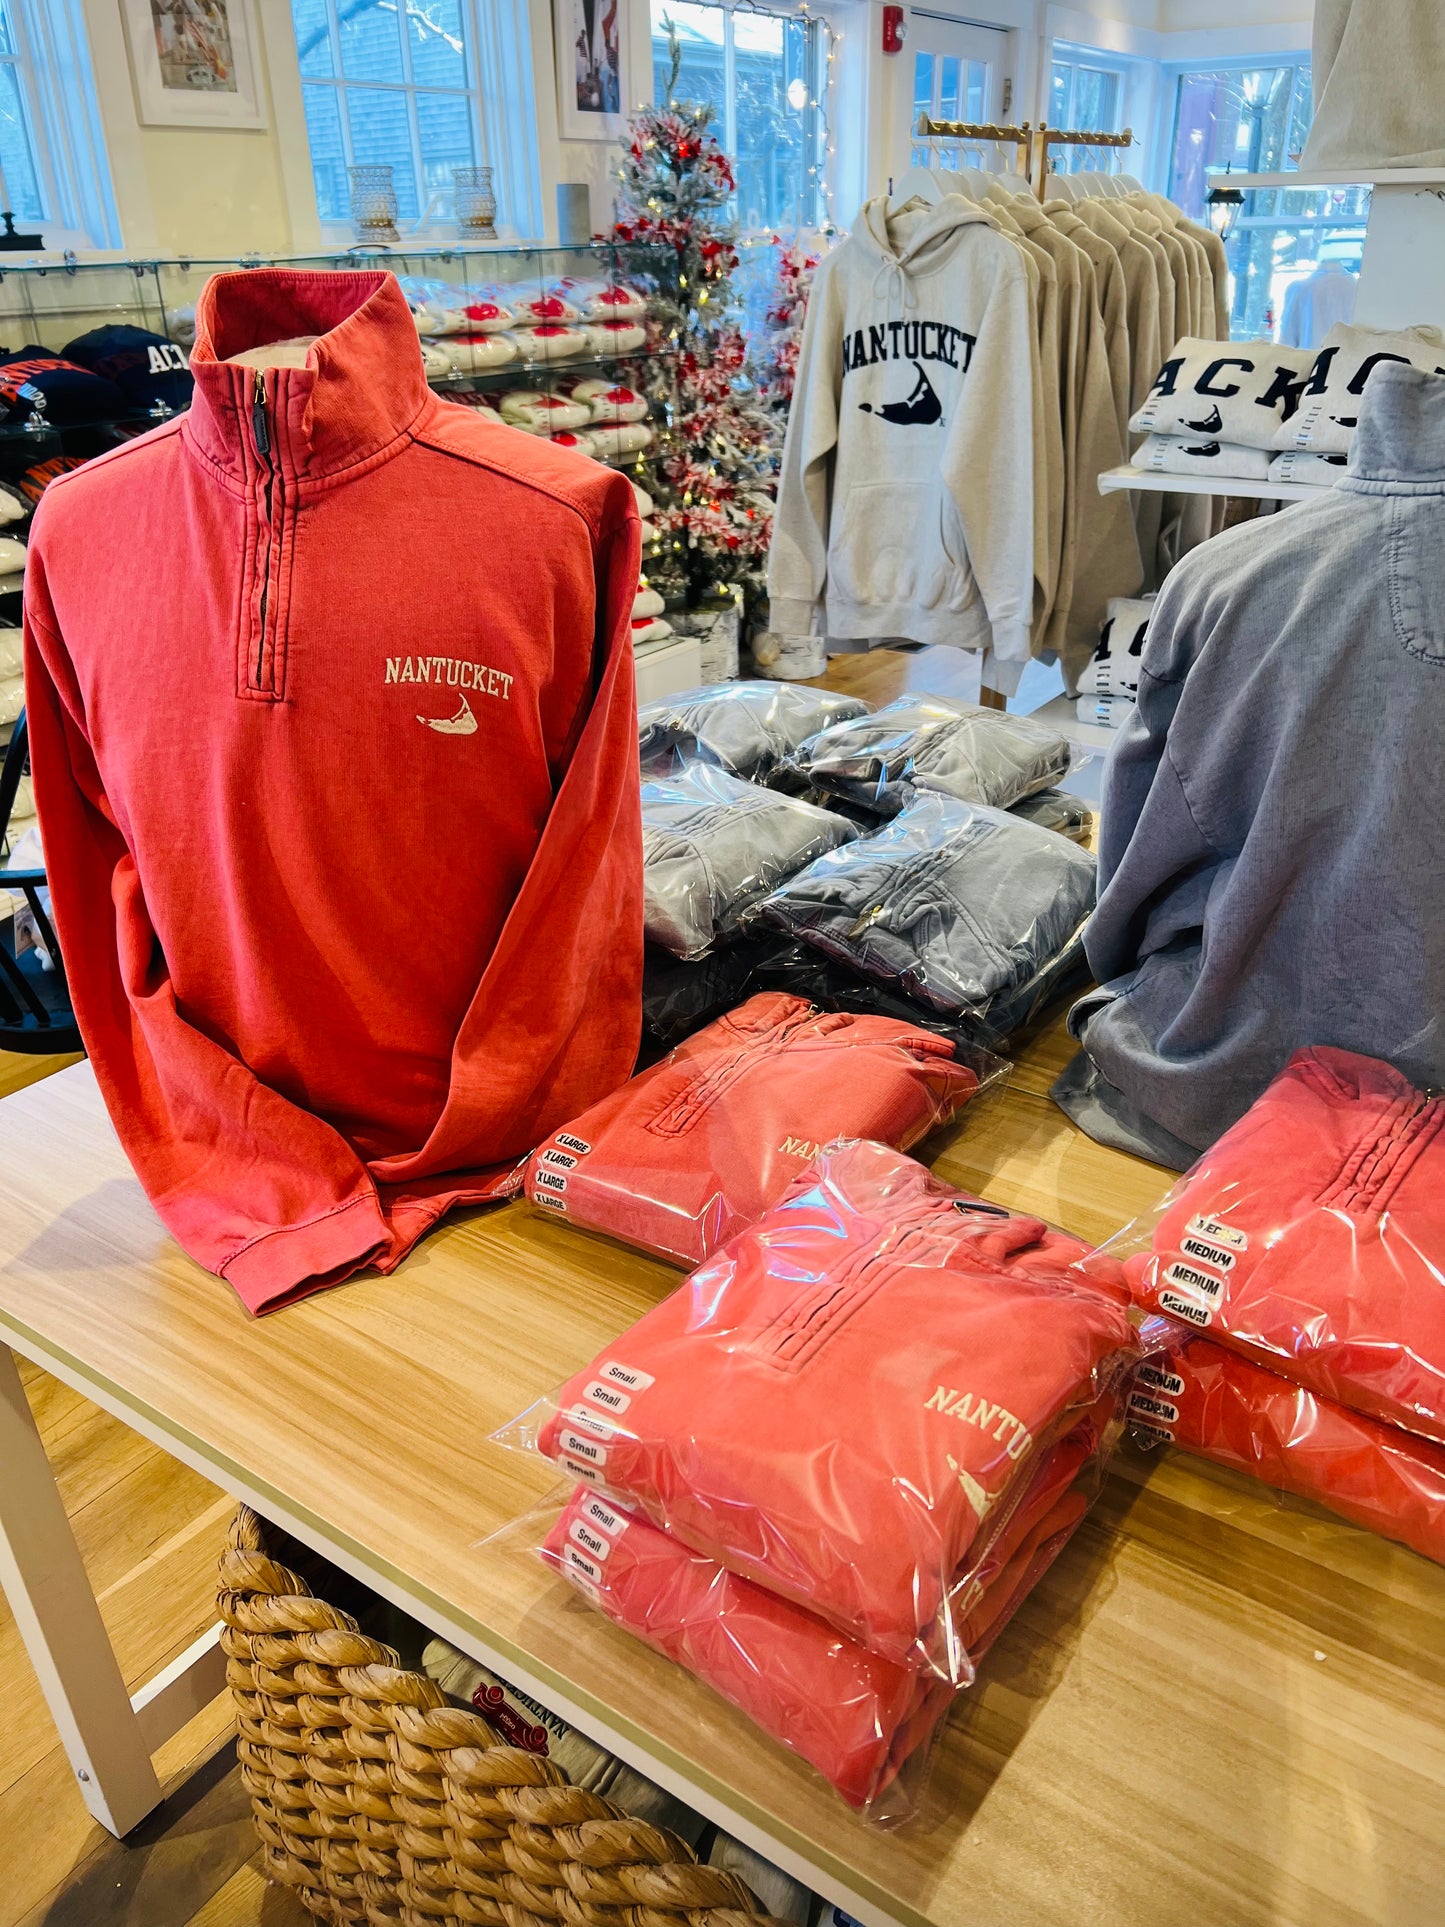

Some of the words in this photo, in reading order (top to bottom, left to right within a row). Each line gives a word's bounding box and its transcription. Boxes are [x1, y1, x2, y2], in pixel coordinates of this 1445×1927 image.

[842, 321, 977, 378] NANTUCKET
[1152, 357, 1309, 423] ACK
[384, 656, 514, 700] NANTUCKET
[563, 1136, 589, 1153] LARGE
[550, 1152, 575, 1168] LARGE
[543, 1173, 565, 1190] LARGE
[541, 1194, 565, 1210] LARGE
[1184, 1239, 1232, 1267] MEDIUM
[1172, 1265, 1220, 1296] MEDIUM
[1161, 1293, 1208, 1325] MEDIUM
[609, 1367, 637, 1385] Small
[592, 1387, 621, 1407] Small
[569, 1437, 597, 1459] Small
[590, 1504, 615, 1528] Small
[577, 1528, 602, 1553] Small
[571, 1552, 594, 1577] Small
